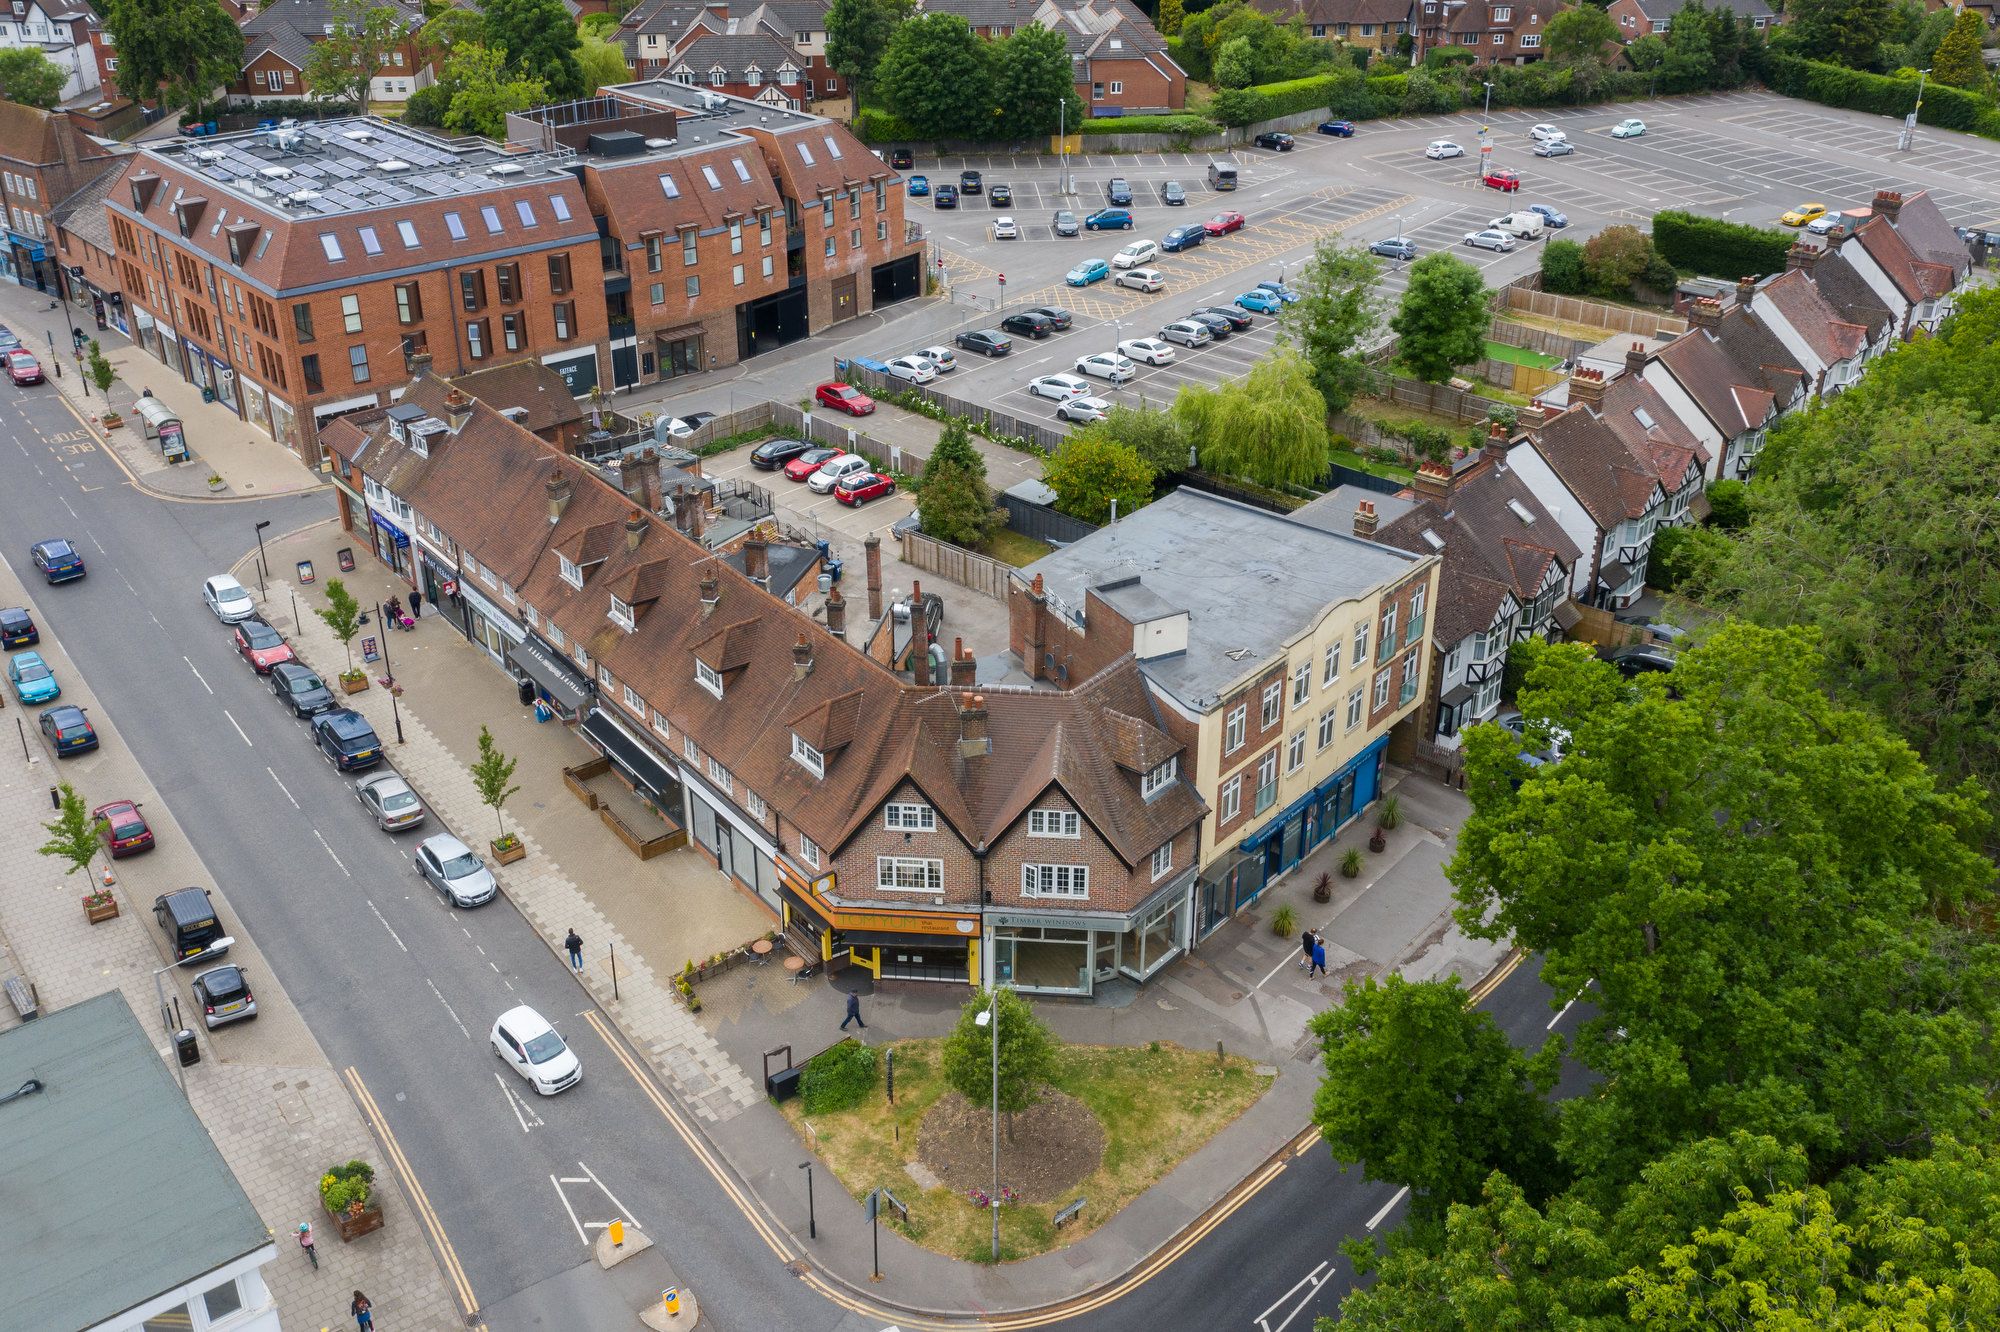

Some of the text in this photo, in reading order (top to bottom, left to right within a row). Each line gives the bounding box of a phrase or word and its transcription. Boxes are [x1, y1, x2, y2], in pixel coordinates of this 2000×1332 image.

[50, 430, 89, 444] STOP
[62, 442, 96, 454] BUS
[838, 912, 917, 929] TOM YUM
[1010, 915, 1041, 924] TIMBER
